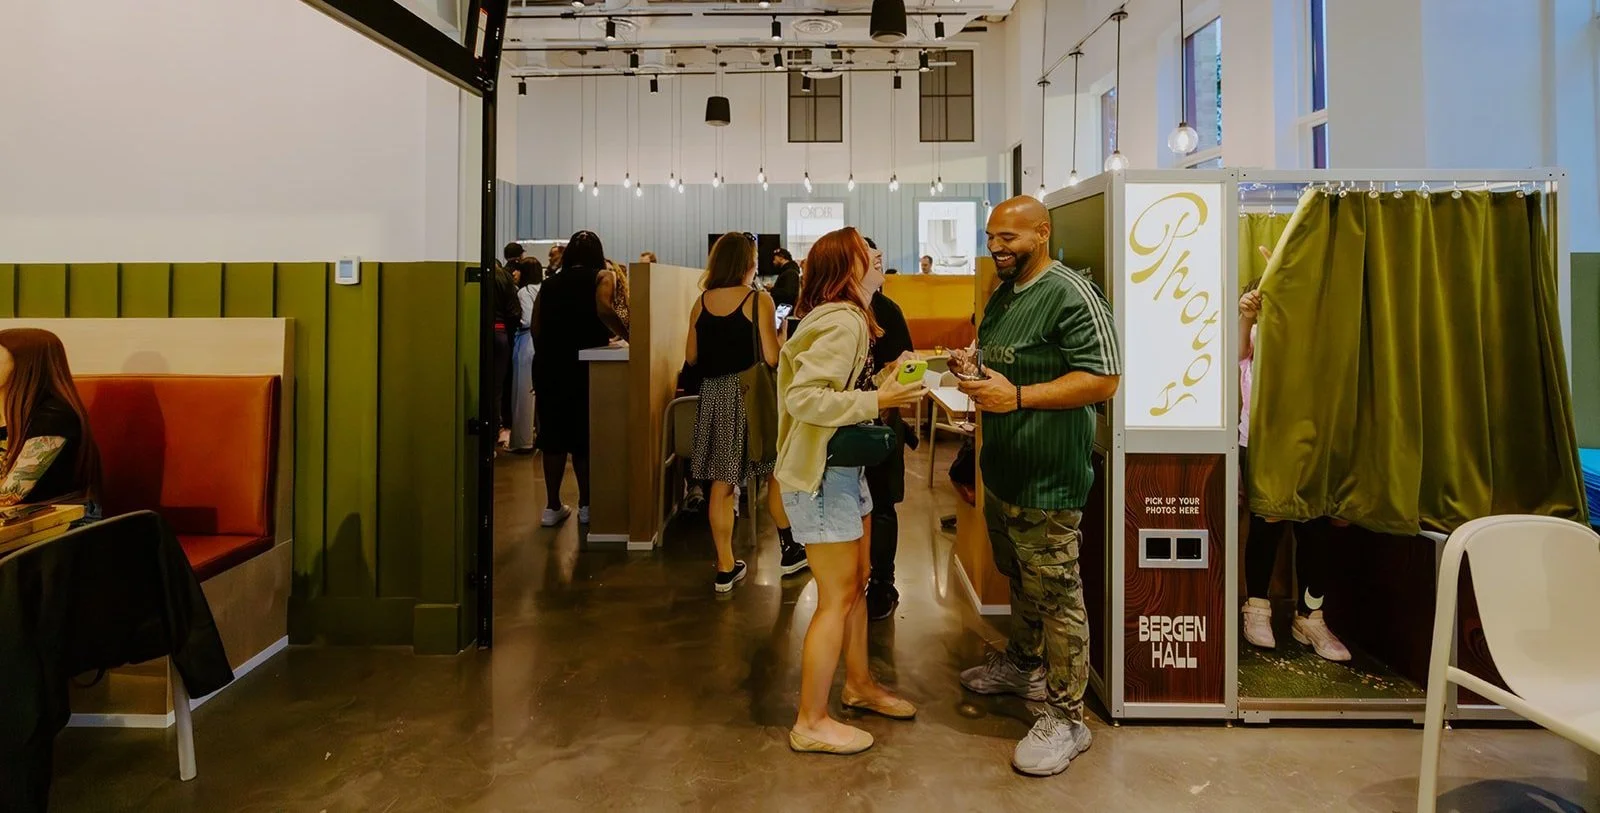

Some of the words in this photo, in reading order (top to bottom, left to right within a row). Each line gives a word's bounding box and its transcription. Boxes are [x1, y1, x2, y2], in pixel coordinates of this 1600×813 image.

[1129, 192, 1218, 416] Photos
[1145, 497, 1163, 505] PICK
[1165, 497, 1177, 505] UP
[1179, 497, 1200, 505] YOUR
[1145, 506, 1177, 514] PHOTOS
[1179, 506, 1200, 514] HERE
[1138, 615, 1207, 642] BERGEN
[1151, 642, 1198, 669] HALL
